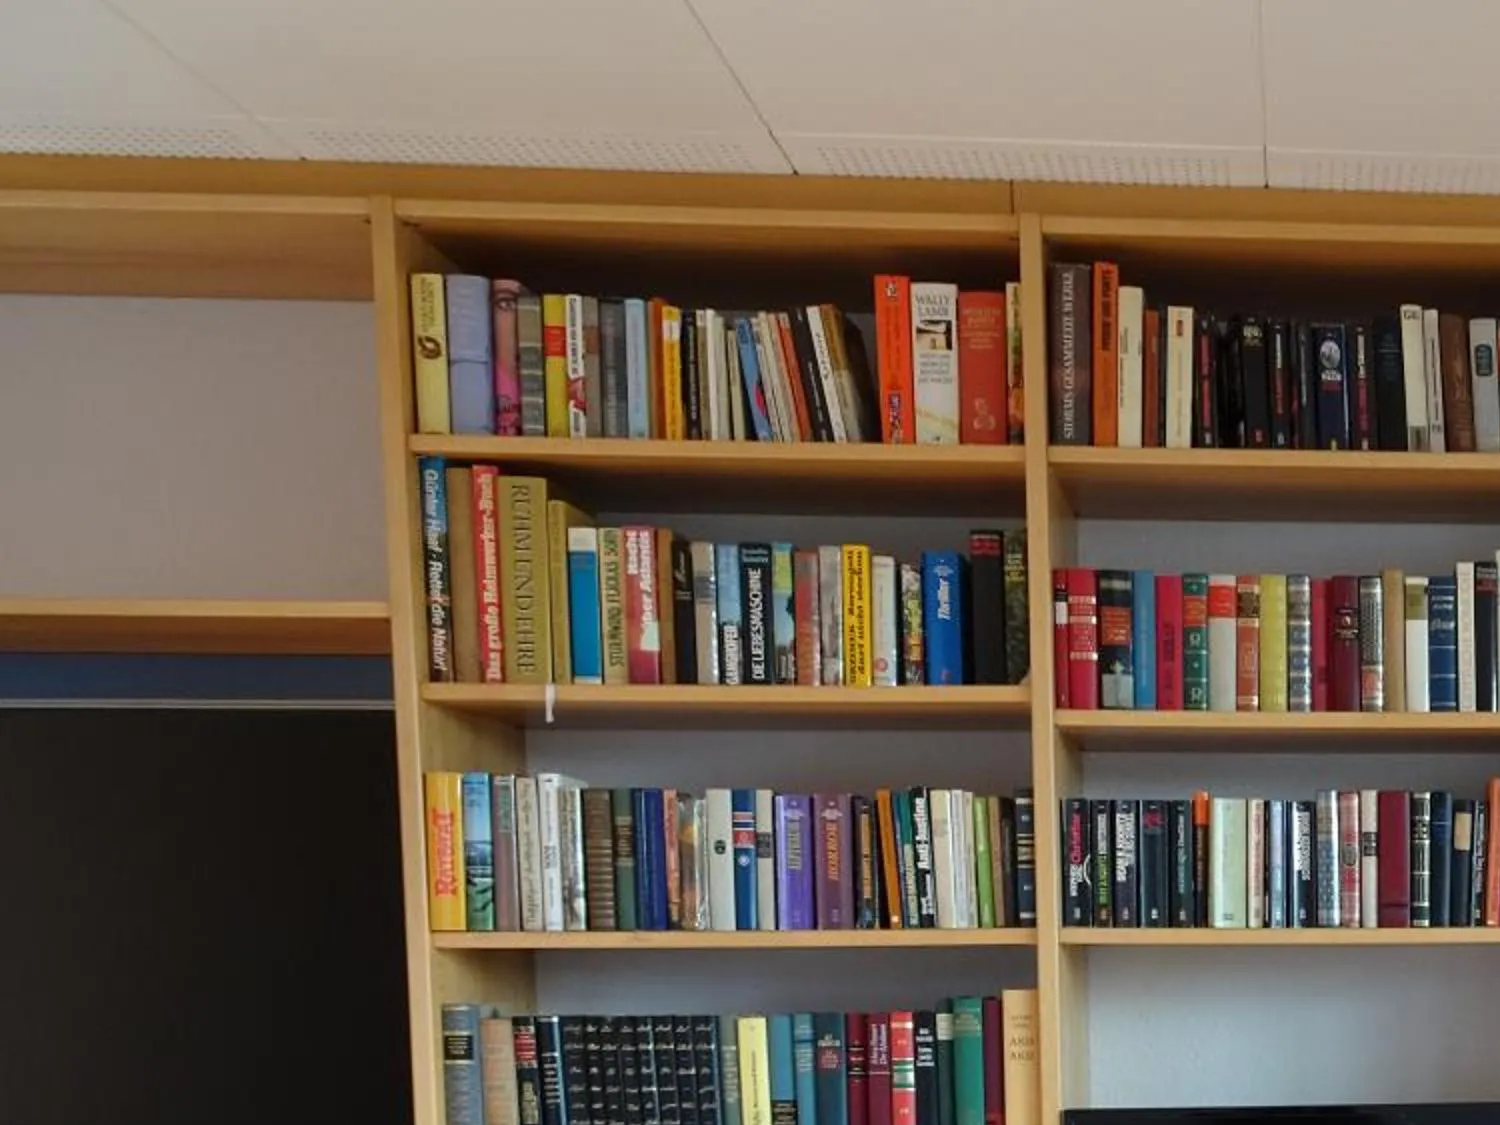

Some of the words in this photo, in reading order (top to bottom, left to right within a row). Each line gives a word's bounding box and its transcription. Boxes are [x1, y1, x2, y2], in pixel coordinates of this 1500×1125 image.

[511, 485, 533, 551] RUHM
[513, 558, 535, 611] UND
[936, 578, 952, 620] Thriller
[431, 604, 445, 625] die
[747, 567, 765, 661] LIEBESMASCHINE
[486, 651, 502, 681] Das
[515, 616, 537, 675] EHRE
[724, 624, 740, 686] GANGHOFER
[750, 660, 766, 680] DIE
[824, 822, 840, 881] HORROR
